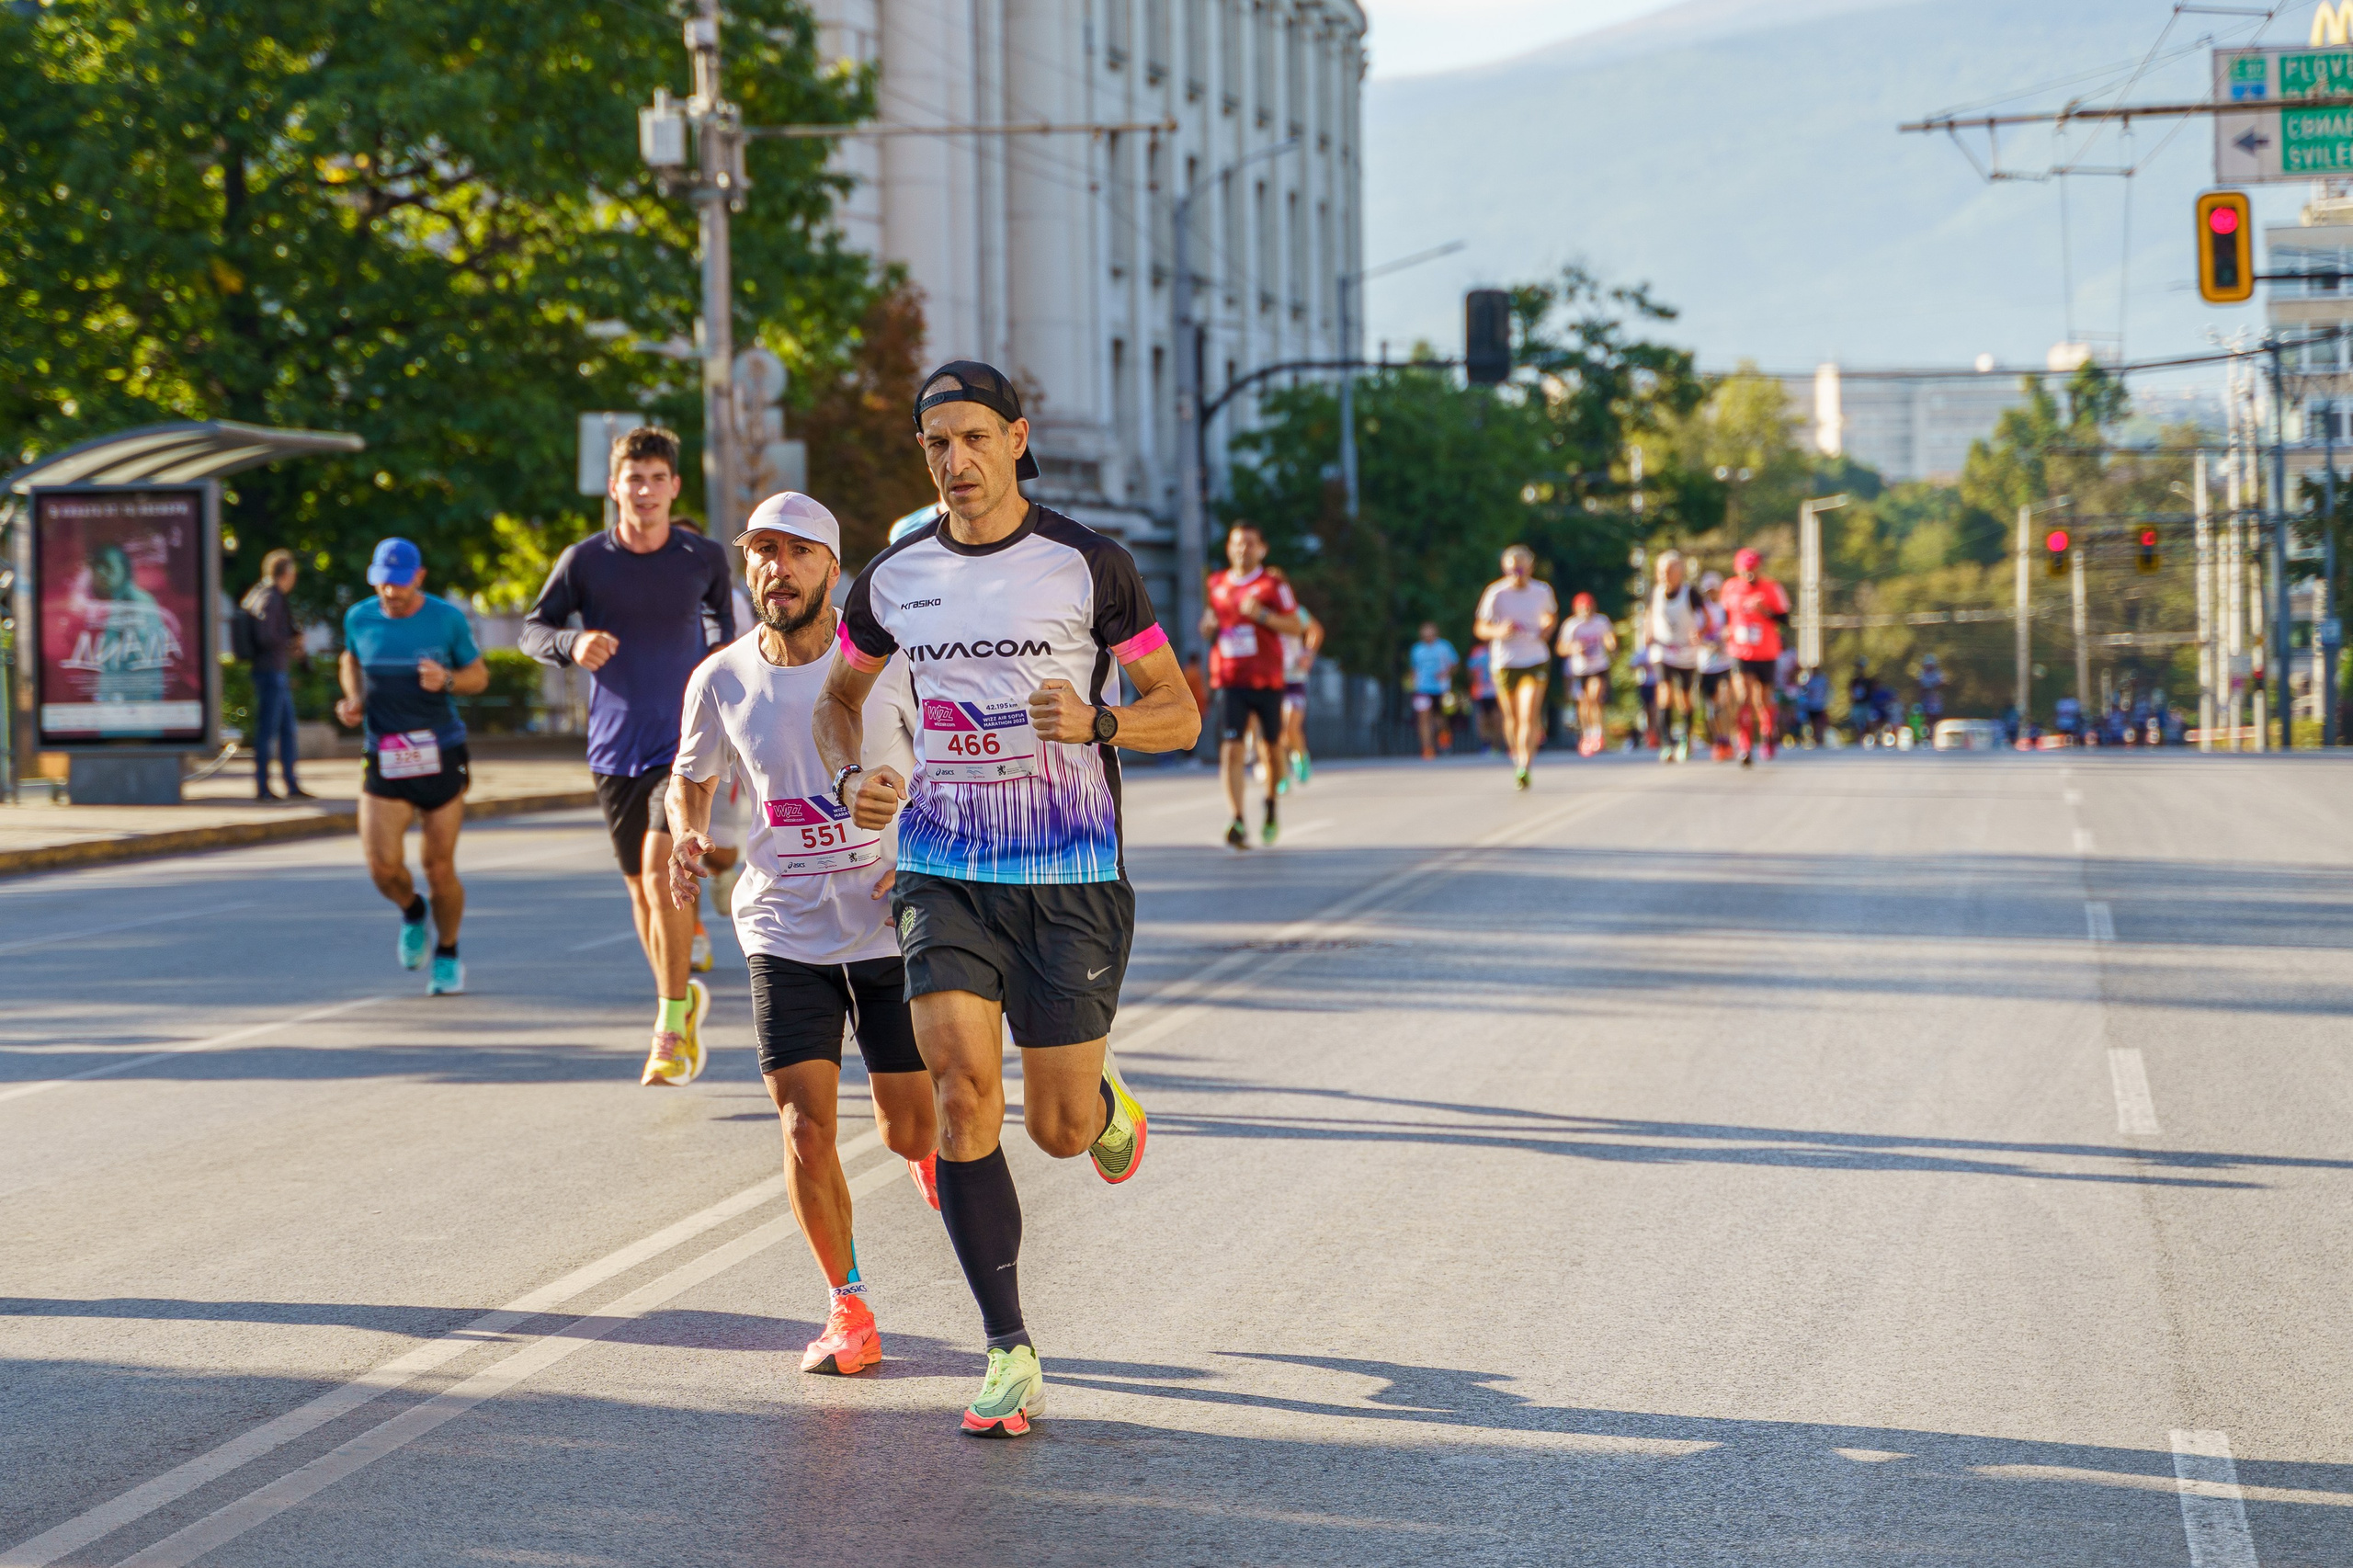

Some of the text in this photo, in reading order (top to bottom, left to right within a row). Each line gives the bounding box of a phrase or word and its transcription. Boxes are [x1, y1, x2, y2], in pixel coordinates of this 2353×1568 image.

[2288, 141, 2353, 171] SVILE
[903, 640, 1051, 662] VIVACOM
[986, 702, 1008, 710] 42.195
[948, 733, 1000, 756] 466
[801, 823, 847, 849] 551
